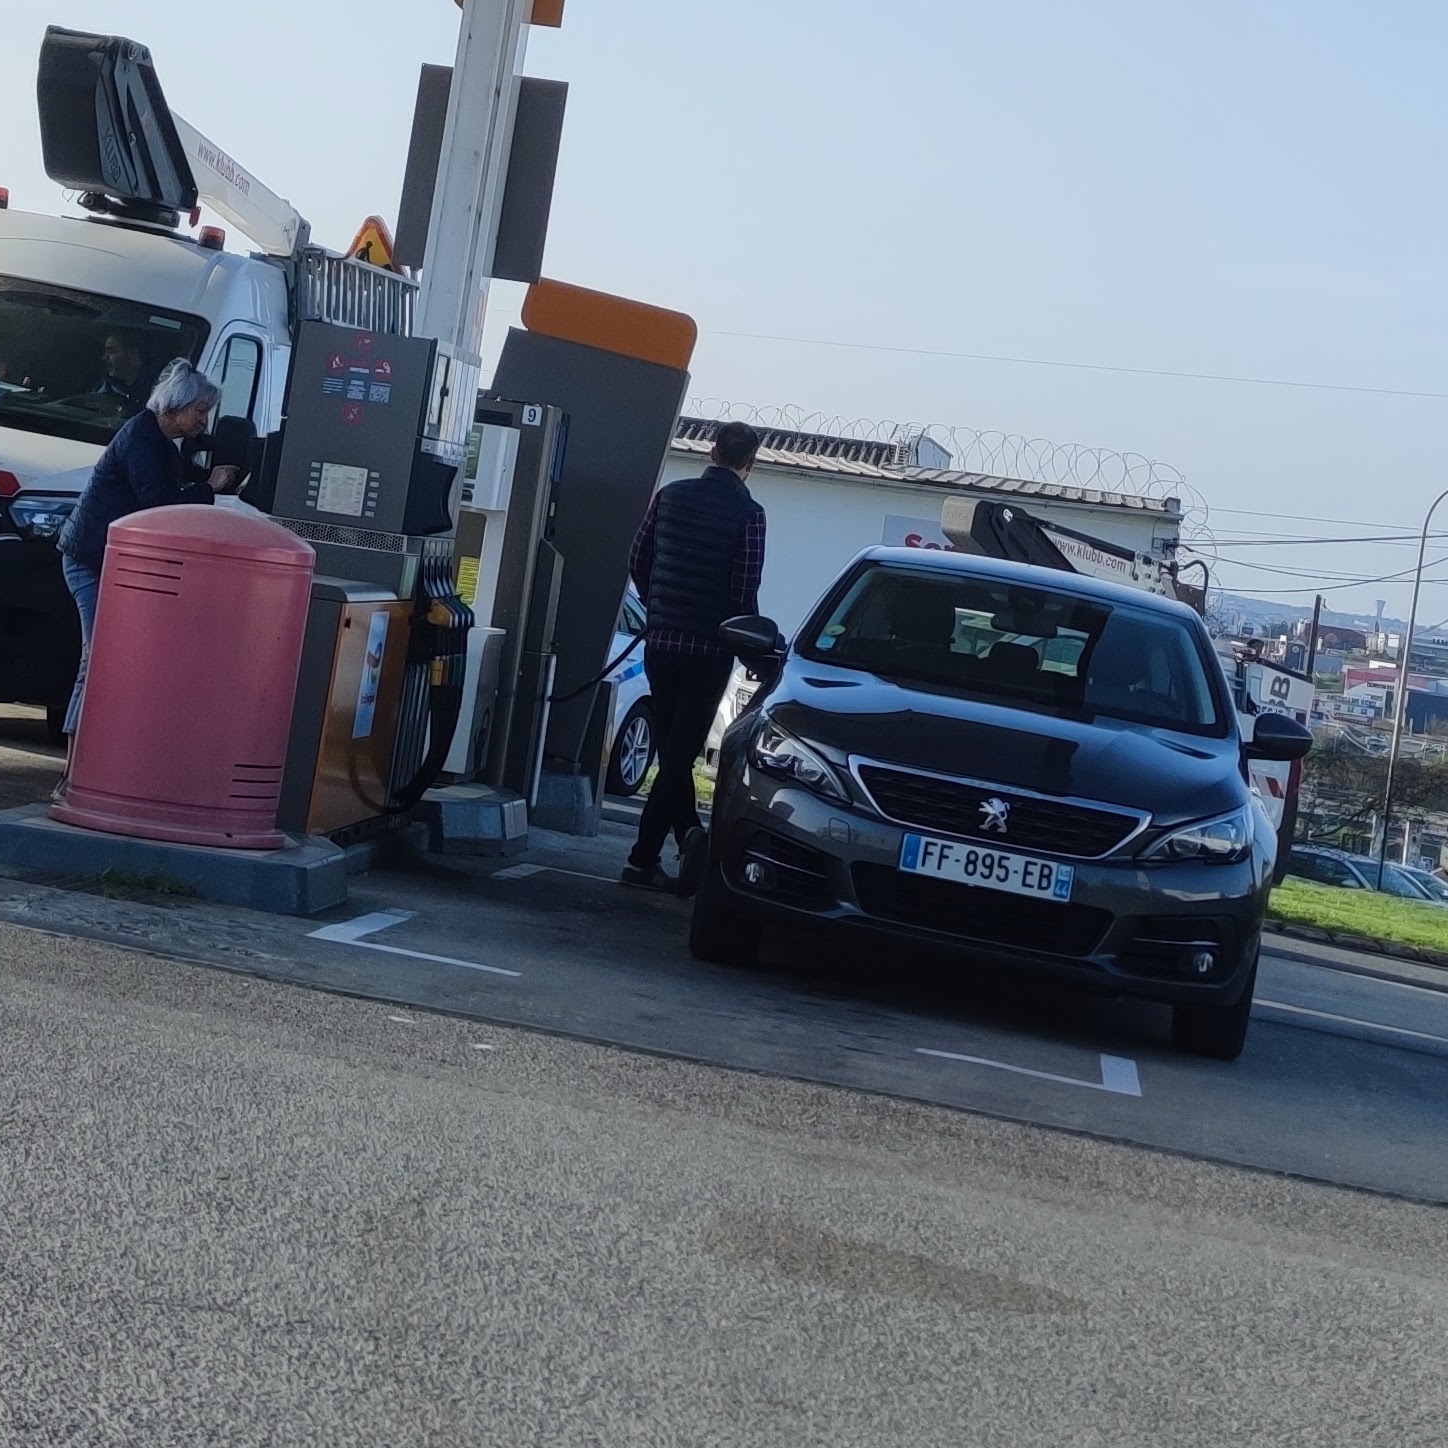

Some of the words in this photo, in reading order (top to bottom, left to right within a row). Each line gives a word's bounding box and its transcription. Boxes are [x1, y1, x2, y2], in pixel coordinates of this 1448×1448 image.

[197, 139, 251, 196] www.klubb.com
[527, 408, 537, 423] 9
[920, 840, 1054, 891] FF-895-EB
[1054, 882, 1068, 896] 44
